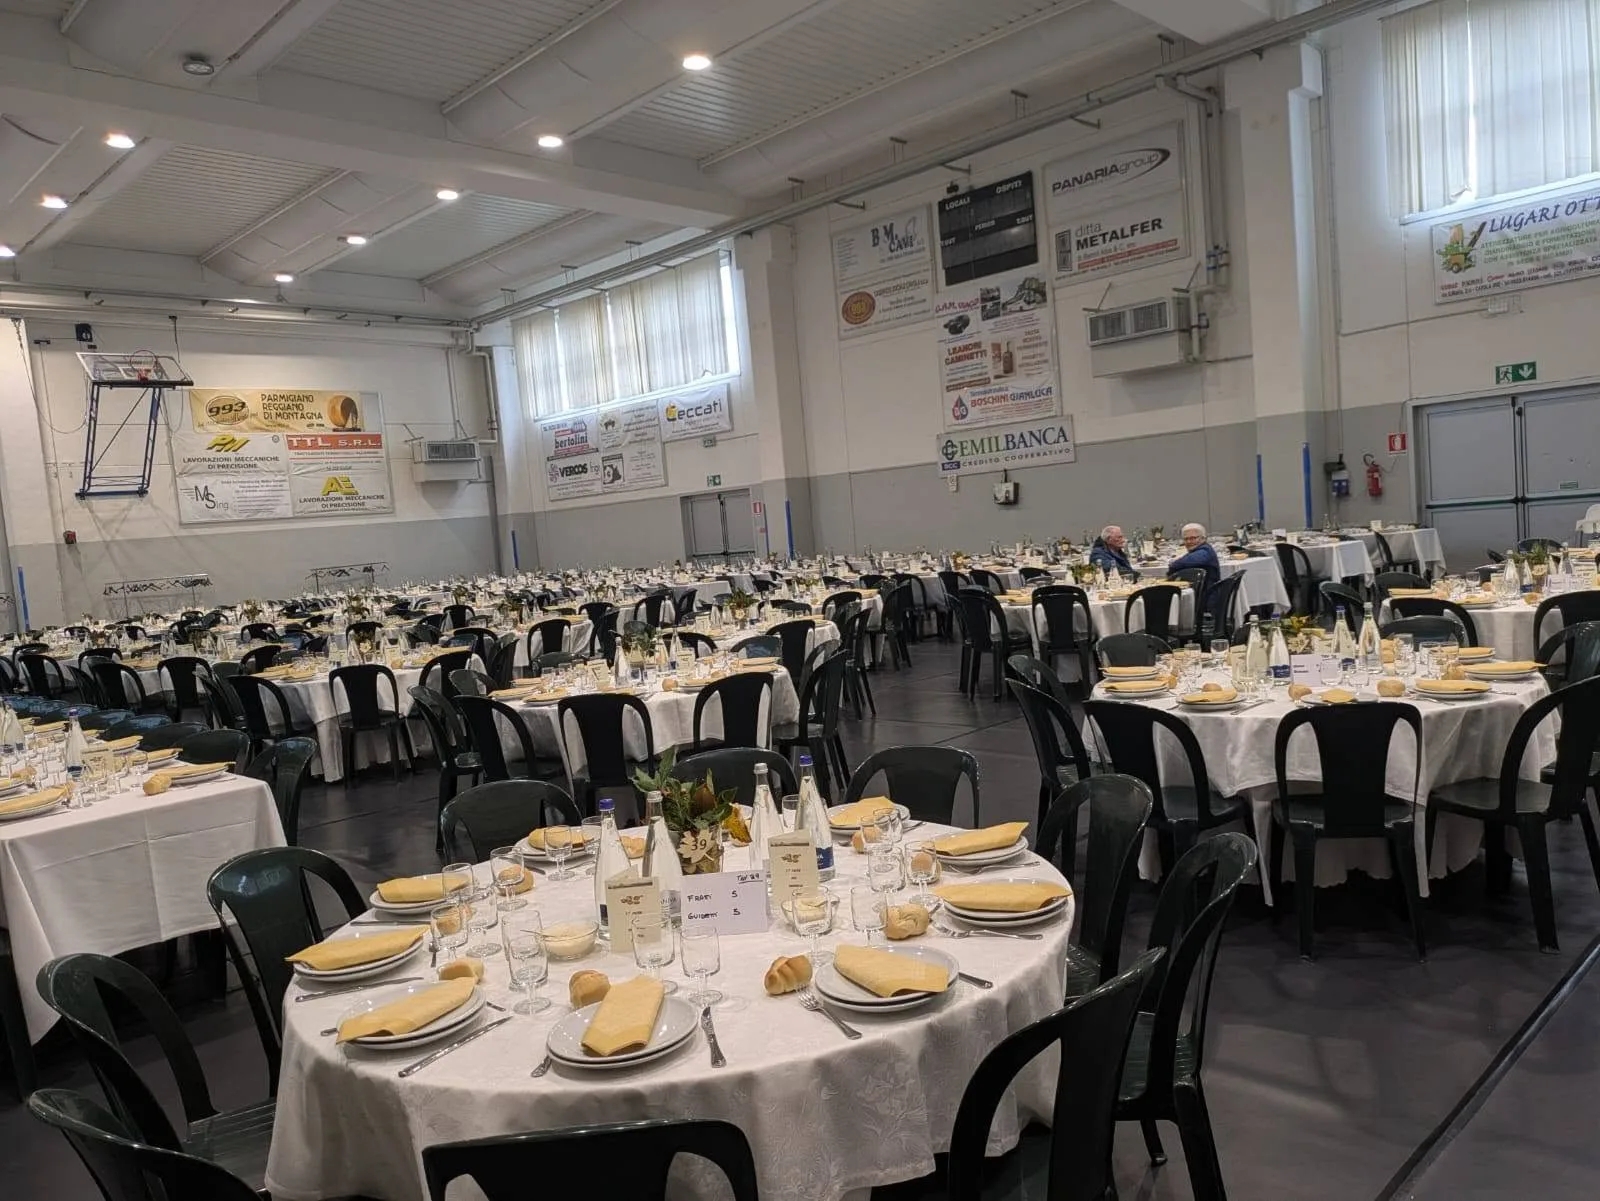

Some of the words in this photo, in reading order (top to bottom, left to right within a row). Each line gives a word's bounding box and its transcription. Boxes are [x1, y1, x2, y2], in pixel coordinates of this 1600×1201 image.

[1052, 153, 1159, 193] PANARIAgroup
[996, 180, 1022, 194] OSPITI
[945, 197, 971, 211] LOCALI
[1489, 204, 1560, 232] LUGARI
[1075, 222, 1103, 238] ditta
[1076, 218, 1163, 251] METALFER
[261, 393, 314, 402] PARMIGIANO
[970, 393, 1009, 408] BOSCHINI
[1009, 386, 1053, 402] GIANLUCA
[208, 401, 246, 418] 993
[262, 402, 305, 412] REGGIANO
[263, 411, 273, 420] DI
[275, 411, 323, 420] MONTAGNA
[288, 437, 331, 447] TTL
[554, 431, 588, 449] bertolini
[959, 426, 1069, 457] EMILBANCA
[962, 457, 1000, 467] CREDITO
[1004, 447, 1071, 462] COOPERATIVO
[559, 462, 588, 478] VERCOS
[299, 496, 343, 504] LAVORAZIONI
[691, 839, 707, 851] 39
